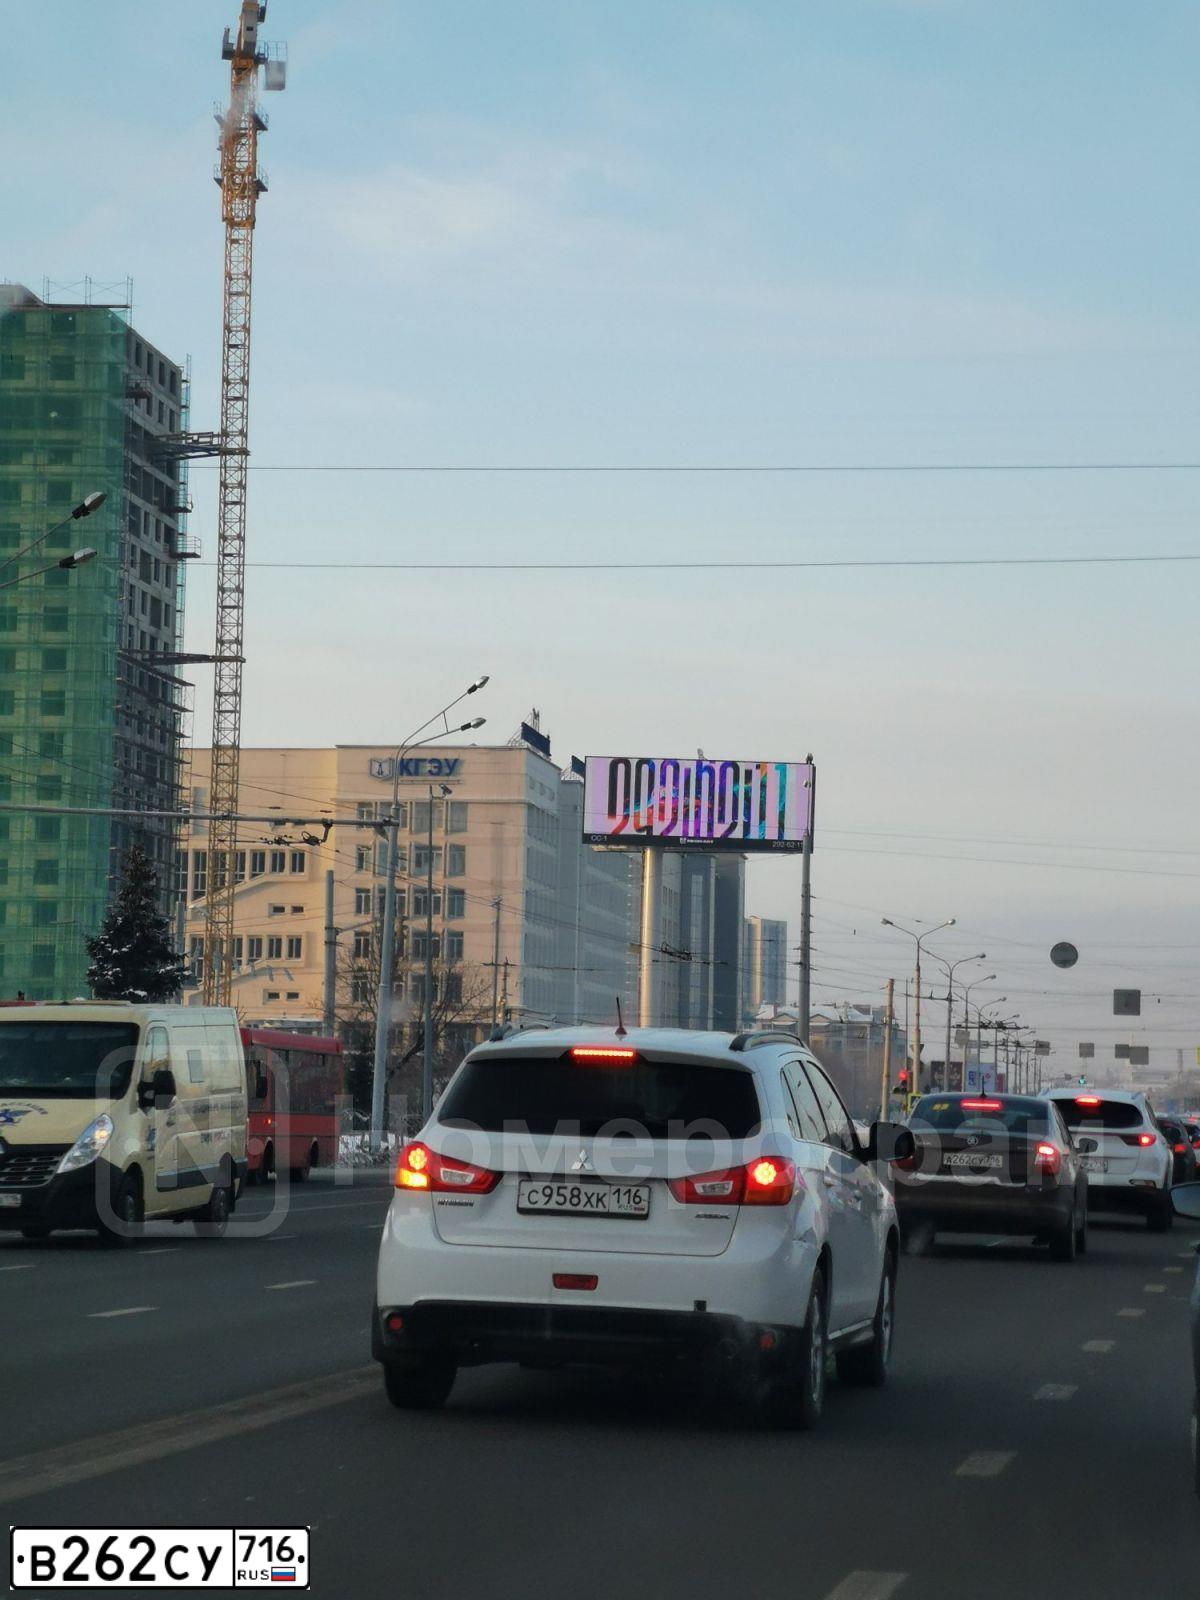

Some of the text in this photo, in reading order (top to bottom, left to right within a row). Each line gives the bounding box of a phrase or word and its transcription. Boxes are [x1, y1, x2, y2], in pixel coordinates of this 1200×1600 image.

[400, 758, 459, 776] КГЭУ
[527, 1185, 642, 1209] С958ХК 116
